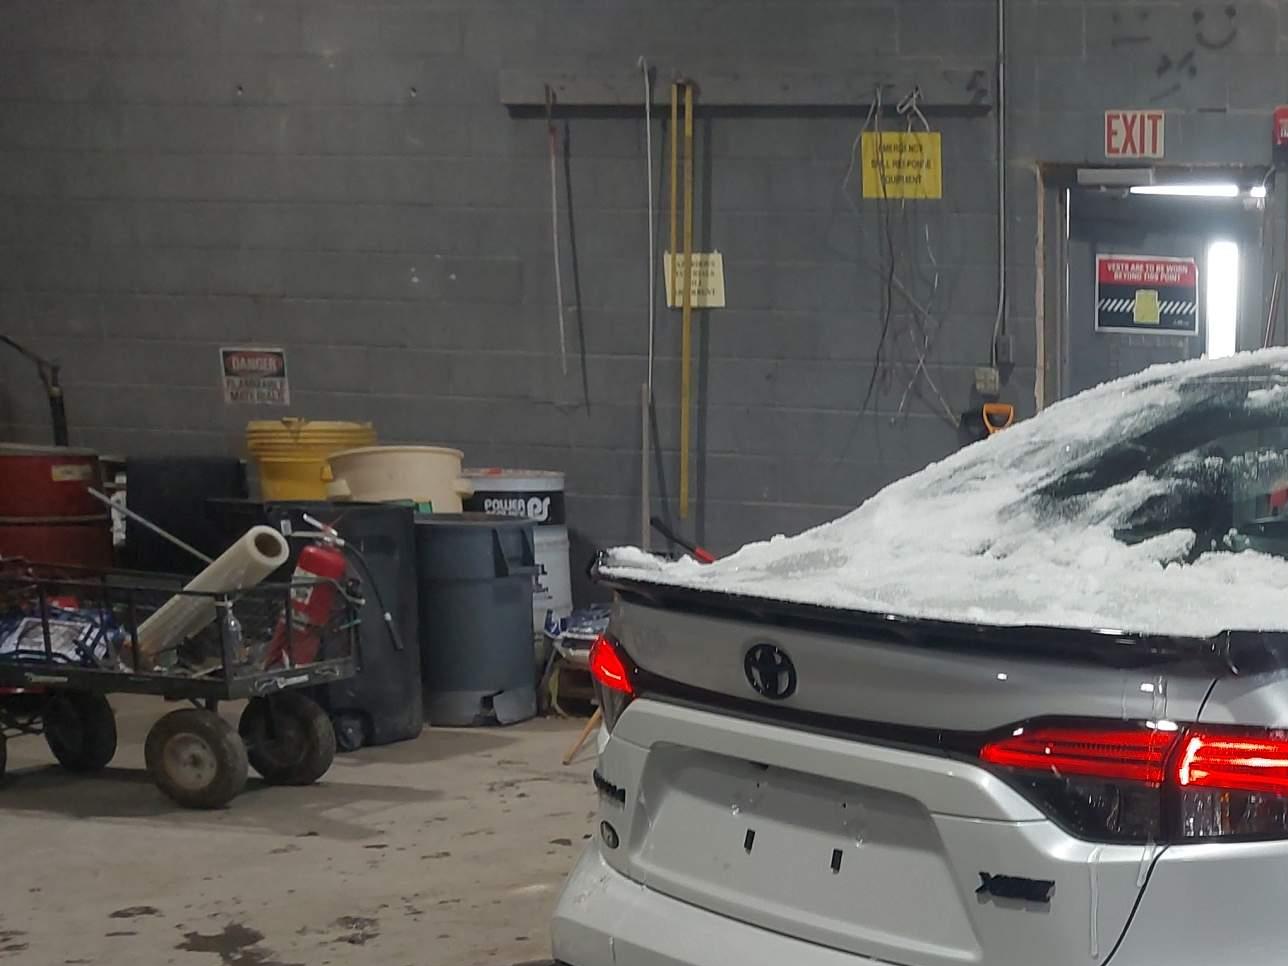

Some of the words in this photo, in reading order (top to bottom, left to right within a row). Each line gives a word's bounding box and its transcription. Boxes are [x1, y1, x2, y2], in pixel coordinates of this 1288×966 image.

[1107, 114, 1163, 154] EXIT
[1107, 262, 1130, 273] VESTS
[1130, 263, 1145, 273] ARE
[1146, 263, 1155, 273] TO
[1156, 264, 1166, 274] BE
[1166, 264, 1188, 274] WORN
[1114, 271, 1142, 281] BEYOND
[1160, 272, 1180, 282] POINT
[232, 357, 277, 369] DANGER
[484, 498, 526, 513] POWER
